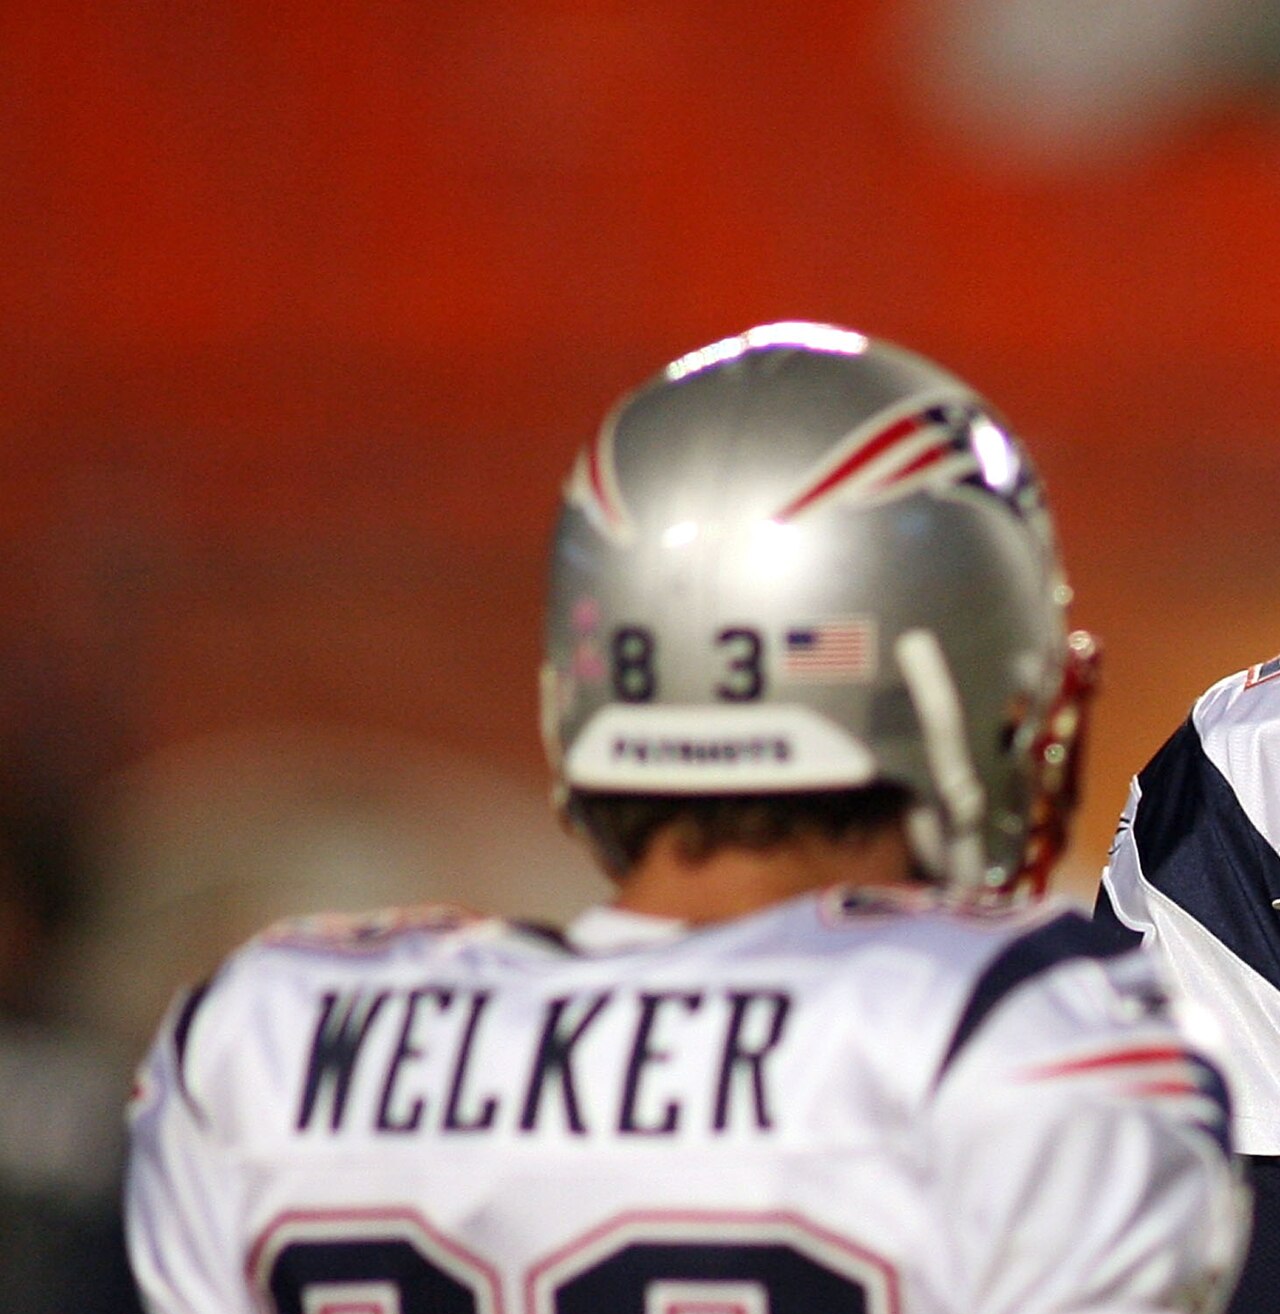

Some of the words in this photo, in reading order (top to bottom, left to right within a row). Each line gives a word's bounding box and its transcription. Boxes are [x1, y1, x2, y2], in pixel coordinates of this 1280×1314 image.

[612, 624, 657, 703] 8
[715, 624, 768, 703] 3
[295, 987, 797, 1137] WELKER
